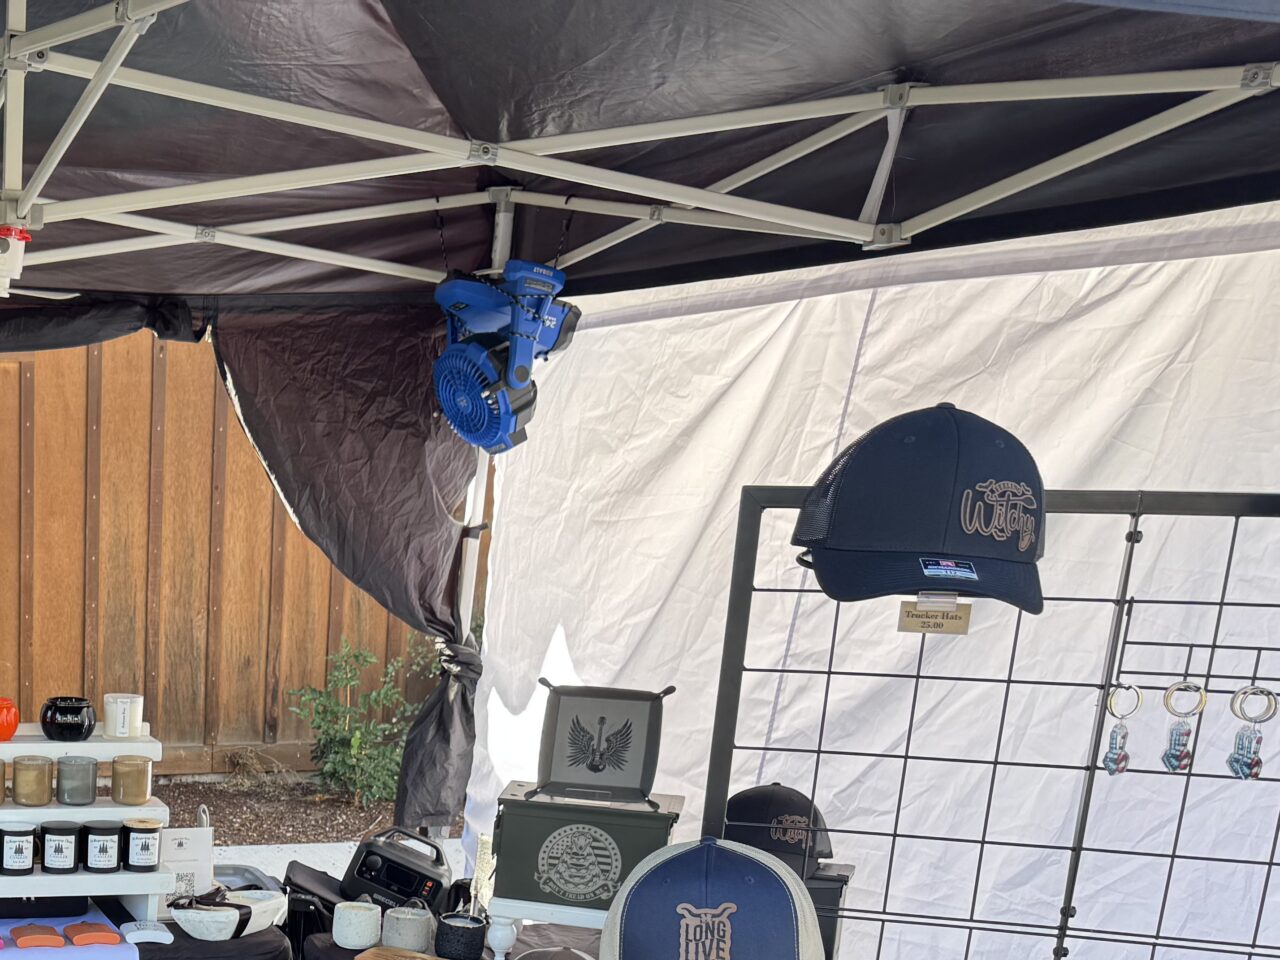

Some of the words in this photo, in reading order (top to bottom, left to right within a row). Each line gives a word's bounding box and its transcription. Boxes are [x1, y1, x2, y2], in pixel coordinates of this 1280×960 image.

[904, 610, 939, 620] Trucker
[941, 611, 963, 621] Hats
[920, 621, 944, 630] 25.00
[685, 920, 727, 943] LONG
